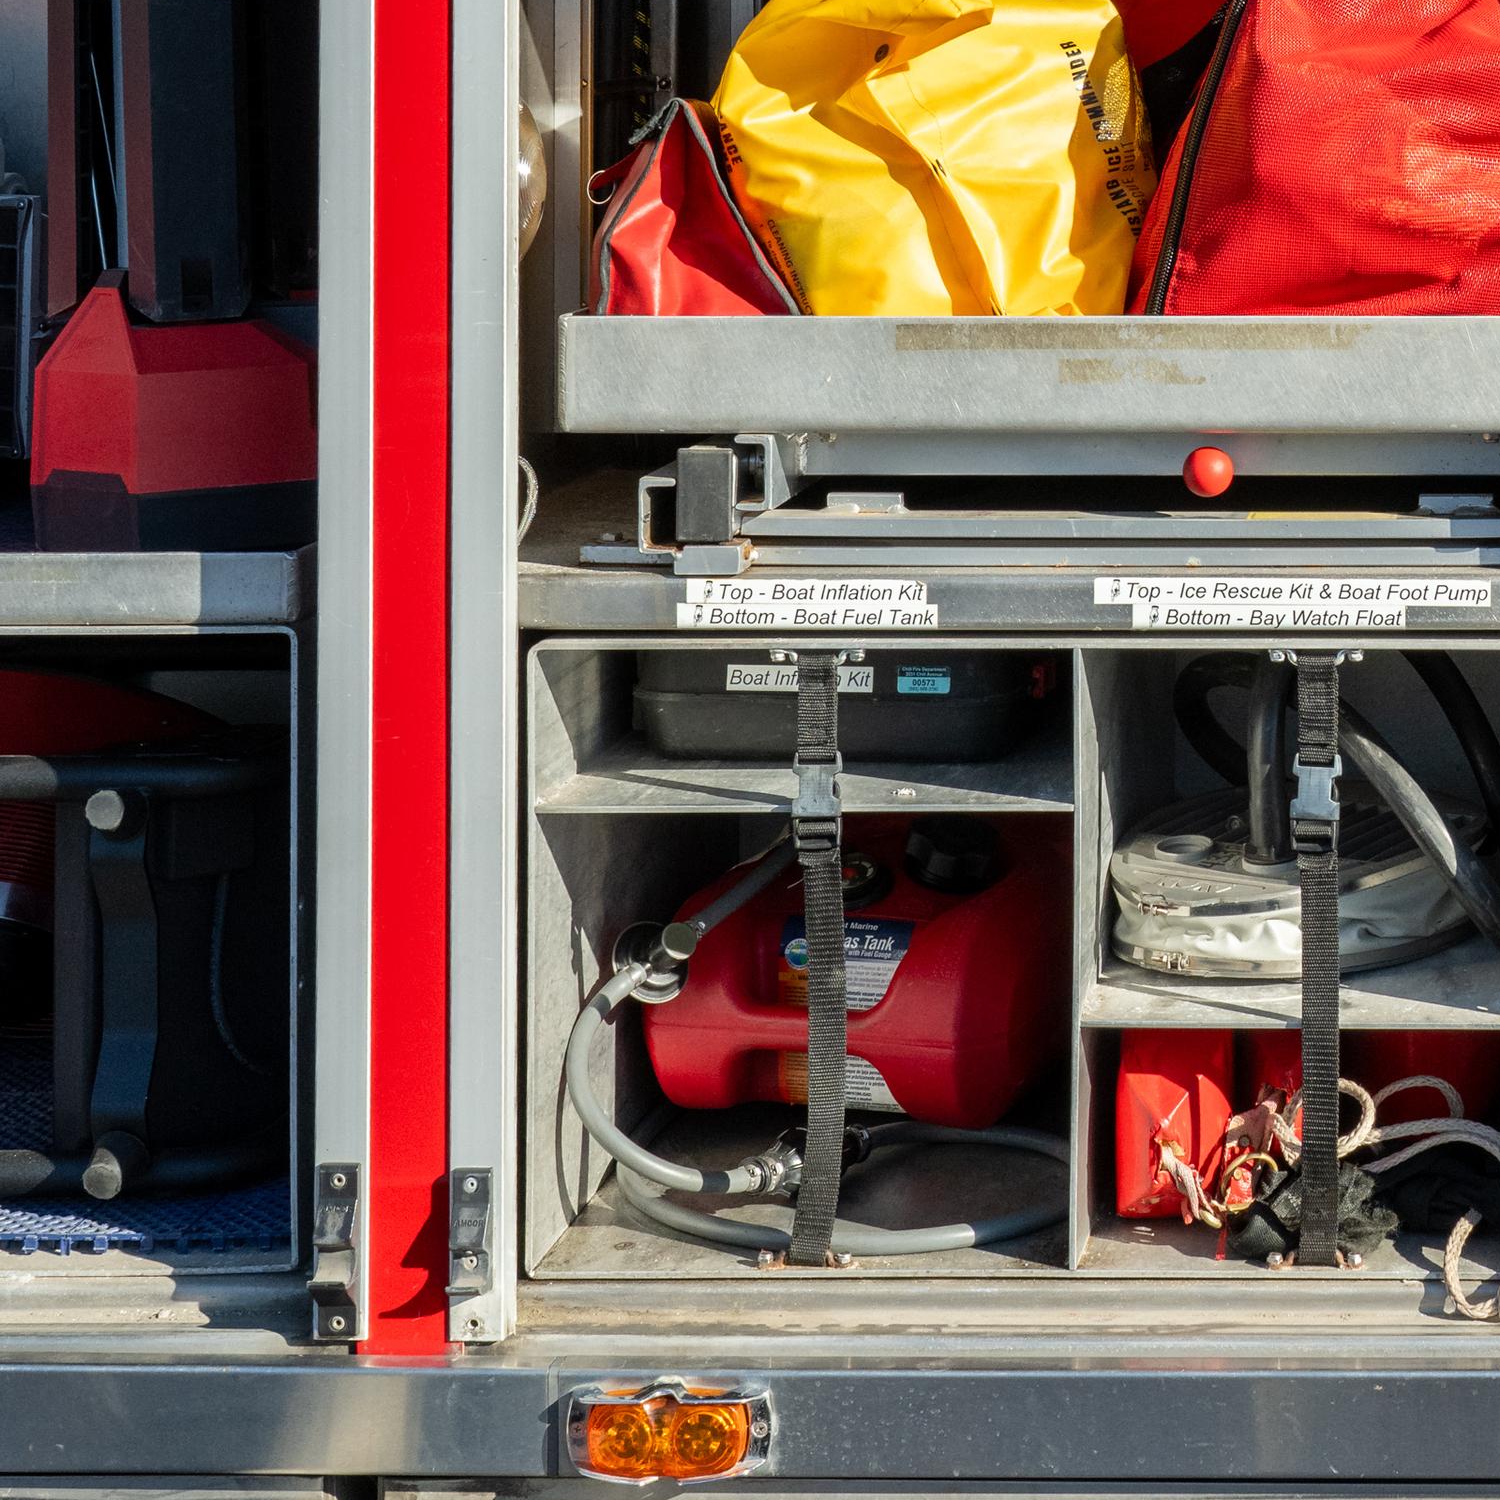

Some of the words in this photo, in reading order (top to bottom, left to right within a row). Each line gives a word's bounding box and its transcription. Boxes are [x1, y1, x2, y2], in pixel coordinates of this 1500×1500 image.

[1103, 146, 1121, 173] ICE
[1106, 180, 1142, 237] USTANG
[767, 219, 794, 269] CLEANING
[719, 584, 753, 604] Top
[772, 584, 814, 600] Boat
[820, 584, 893, 600] Inflation
[899, 585, 924, 601] Kit
[1127, 583, 1161, 603] Top
[1179, 583, 1206, 599] Ice
[1212, 583, 1283, 599] Rescue
[1289, 584, 1314, 599] Kit
[1320, 584, 1332, 599] &
[1338, 584, 1381, 600] Boat
[1387, 585, 1429, 601] Foot
[1434, 585, 1488, 605] Pump
[709, 609, 775, 625] Bottom
[794, 609, 836, 625] Boat
[842, 609, 883, 625] Fuel
[889, 609, 934, 626] Tank
[1165, 609, 1230, 626] Bottom
[1249, 610, 1286, 630] Bay
[1292, 610, 1349, 626] Watch
[1356, 610, 1402, 626] Float
[730, 669, 770, 686] Boat
[847, 671, 871, 687] Kit
[843, 937, 860, 949] as
[863, 935, 895, 951] Tank
